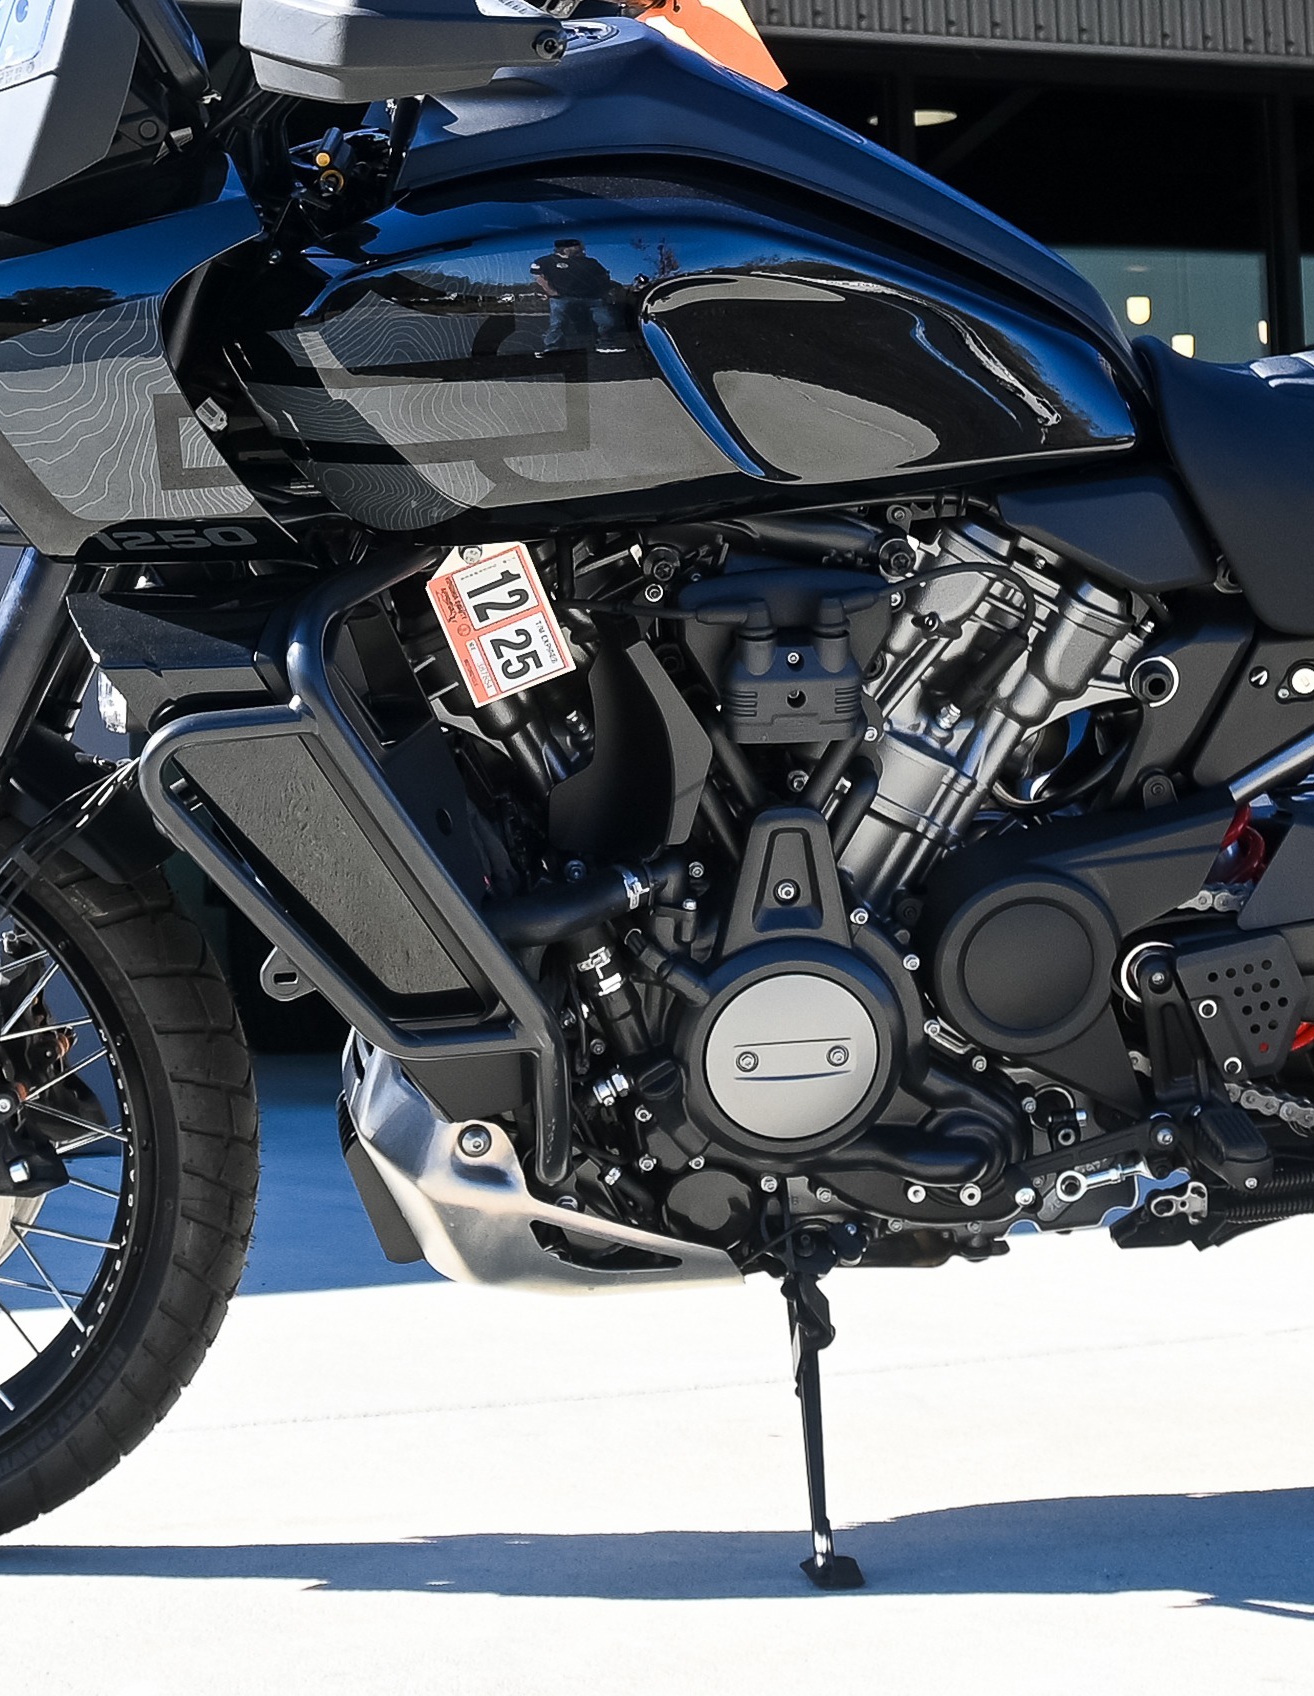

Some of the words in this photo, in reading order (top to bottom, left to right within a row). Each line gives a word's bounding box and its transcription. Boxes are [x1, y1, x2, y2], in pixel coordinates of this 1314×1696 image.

[94, 526, 258, 552] 1250
[466, 569, 530, 623] 12
[490, 628, 543, 680] 25
